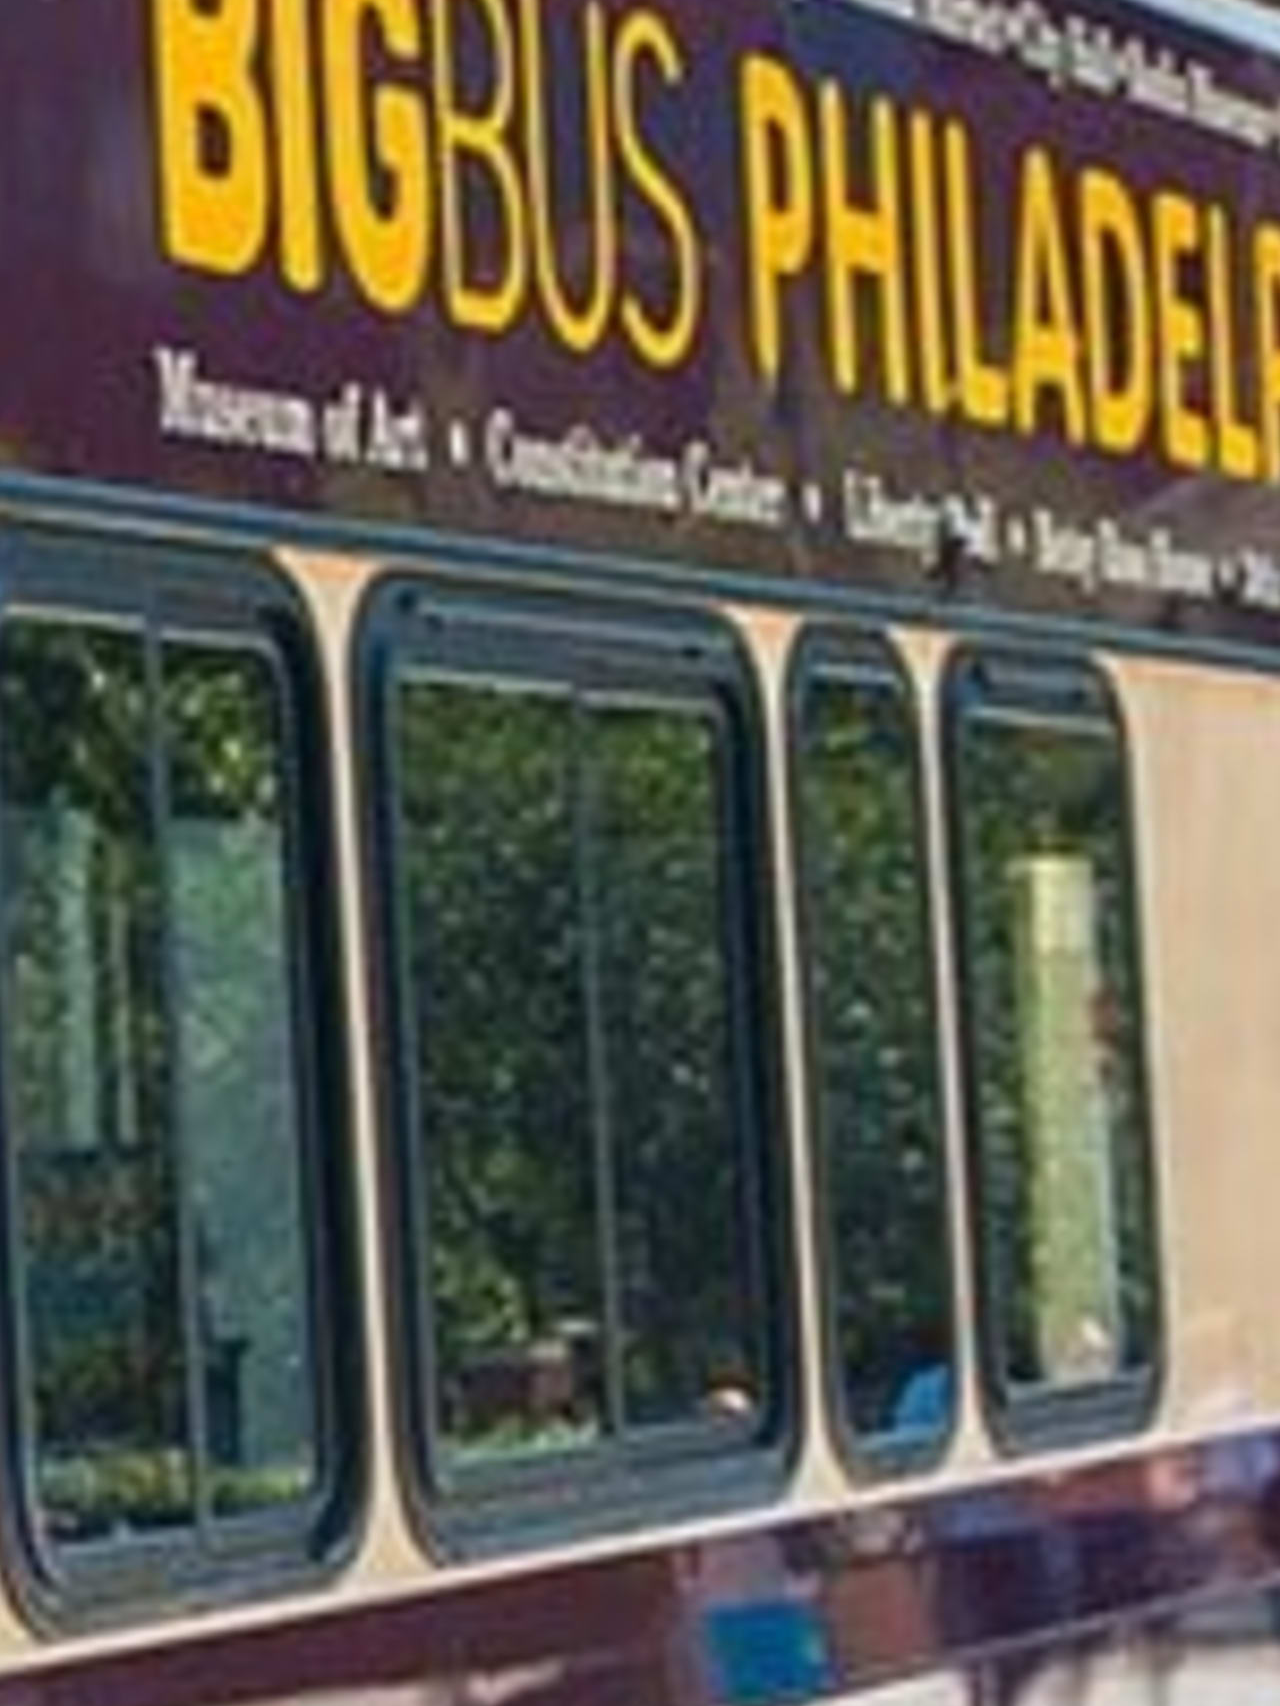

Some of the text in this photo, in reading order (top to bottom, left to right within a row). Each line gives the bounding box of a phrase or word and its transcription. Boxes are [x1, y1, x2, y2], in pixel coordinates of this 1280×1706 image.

[154, 346, 313, 456] Museum
[323, 382, 361, 460] of
[365, 388, 428, 471] Art
[483, 406, 678, 509] Constitution
[683, 440, 787, 524] Center
